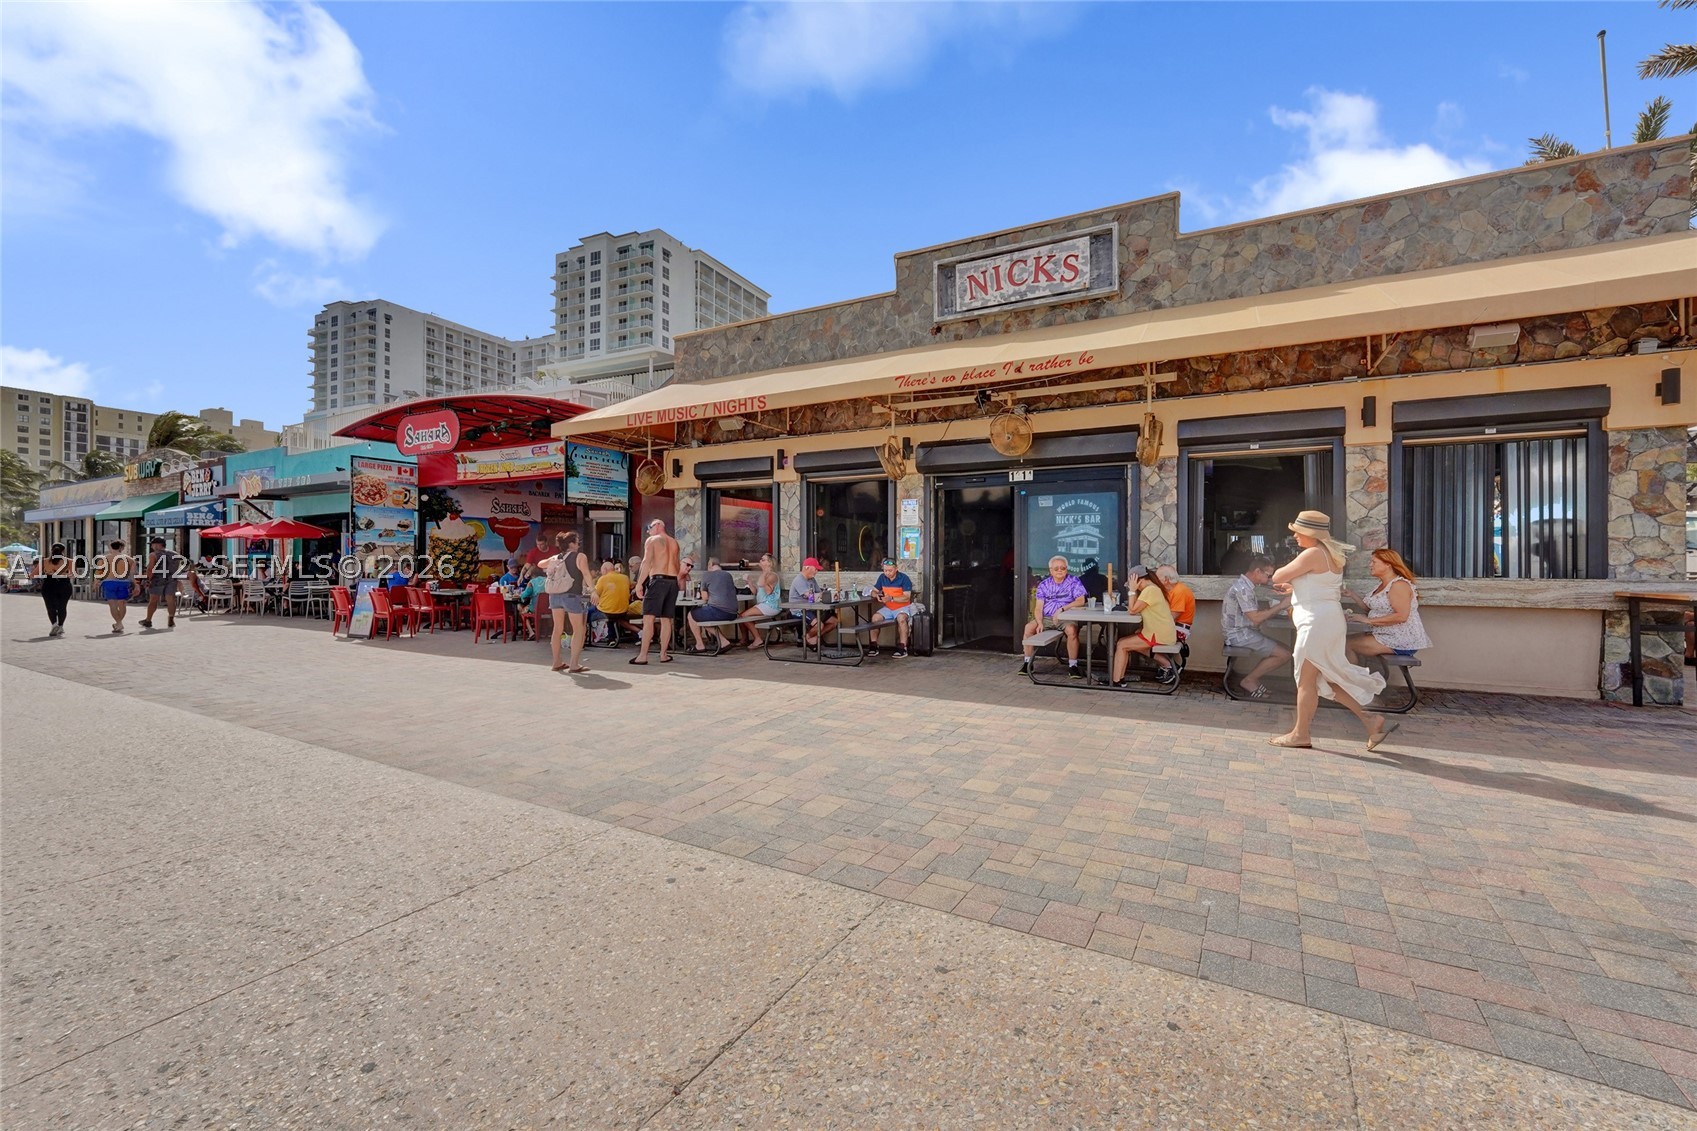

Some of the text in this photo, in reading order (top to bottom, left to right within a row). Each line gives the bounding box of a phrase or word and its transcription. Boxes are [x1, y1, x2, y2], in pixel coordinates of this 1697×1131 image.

[967, 253, 1080, 301] NICKS
[895, 351, 1095, 389] There's no place I'd rather be
[627, 395, 767, 427] LIVE MUSIC 7 NIGHTS
[123, 458, 161, 482] SUBWAY
[358, 461, 376, 470] LARGE
[191, 468, 204, 483] BEN
[1057, 499, 1076, 513] WORLD
[1078, 499, 1100, 512] FAMOUS
[1056, 515, 1101, 524] NICK'S BAR
